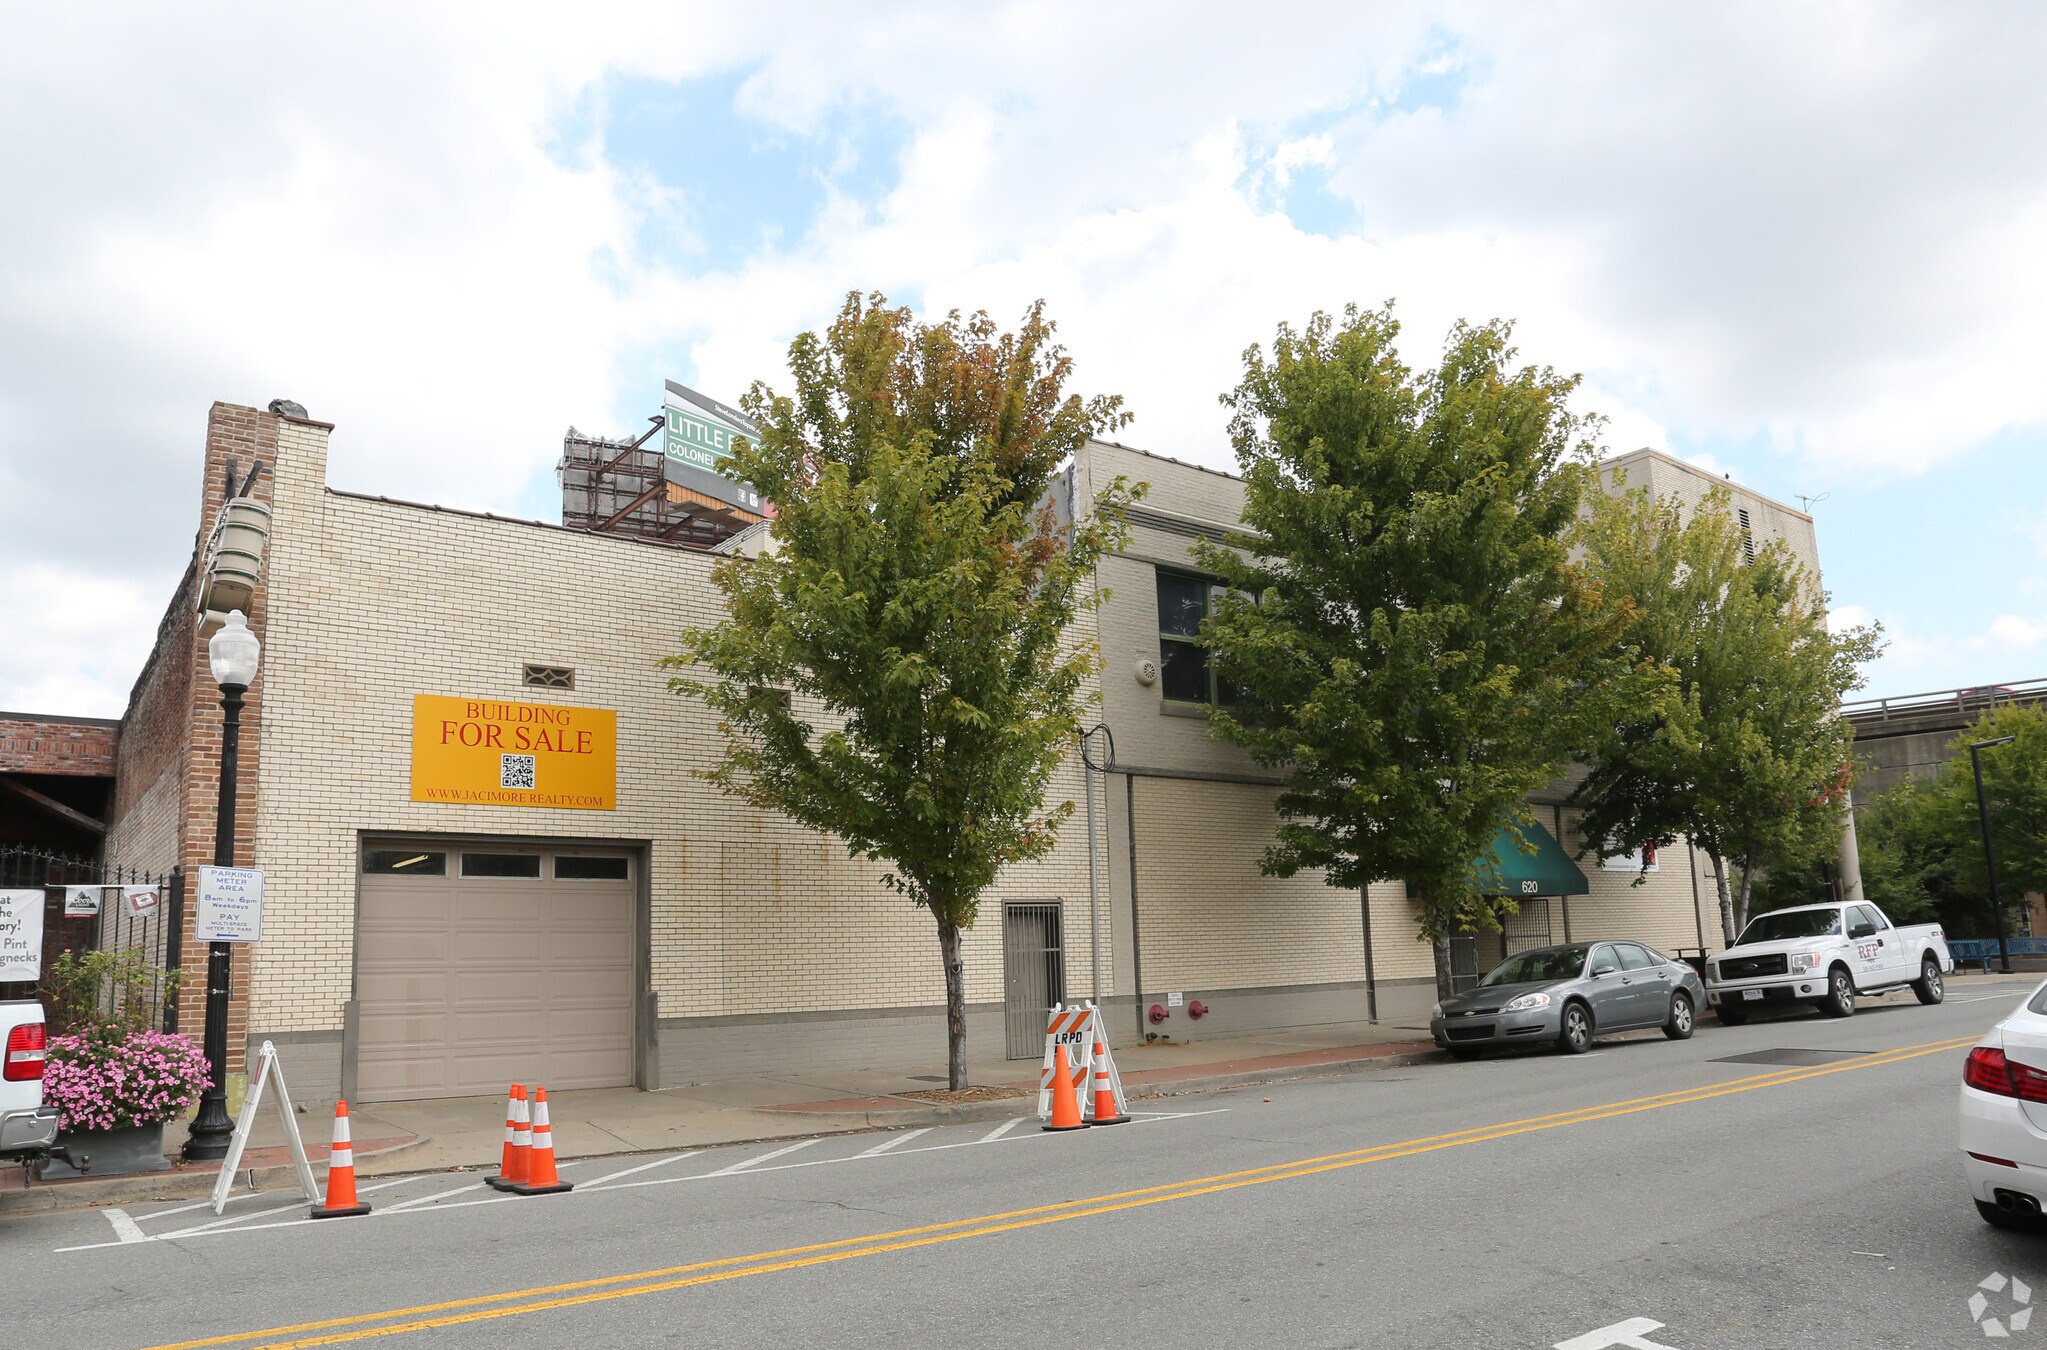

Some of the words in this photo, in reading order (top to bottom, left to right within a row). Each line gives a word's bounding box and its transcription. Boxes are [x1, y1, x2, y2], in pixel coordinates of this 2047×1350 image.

[669, 412, 724, 449] LITTLE
[669, 442, 716, 467] COLONEL
[466, 702, 571, 726] BUILDING
[440, 720, 505, 749] FOR
[515, 726, 593, 754] SALE
[426, 788, 525, 803] WWW.JACIMORE
[529, 794, 602, 806] REALTY.COM
[211, 870, 253, 879] PARKING
[1522, 881, 1538, 893] 620
[239, 896, 257, 904] 6pm
[220, 913, 240, 921] PAY
[4, 937, 28, 950] Pint
[1858, 943, 1878, 959] RFP
[1055, 1032, 1082, 1044] LRPD
